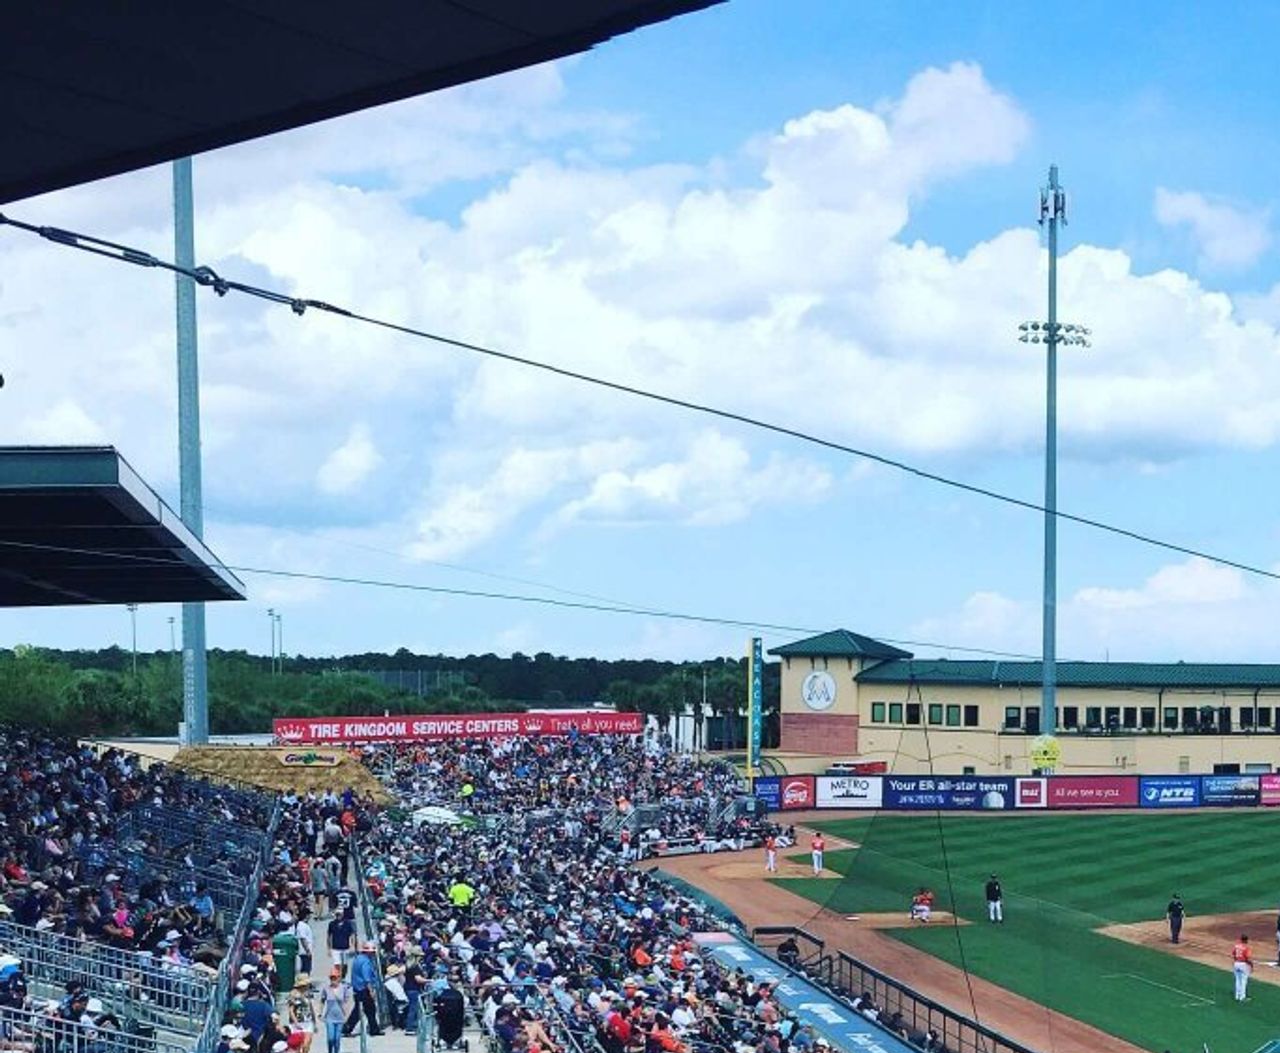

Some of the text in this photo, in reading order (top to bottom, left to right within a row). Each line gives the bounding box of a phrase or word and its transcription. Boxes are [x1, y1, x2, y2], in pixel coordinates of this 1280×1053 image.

[309, 723, 340, 738] TIRE
[345, 722, 406, 738] KINGDOM
[412, 721, 464, 736] SERVICE
[465, 719, 519, 734] CENTERS
[831, 778, 870, 790] METRO
[889, 780, 1008, 792] Your ER all-star team
